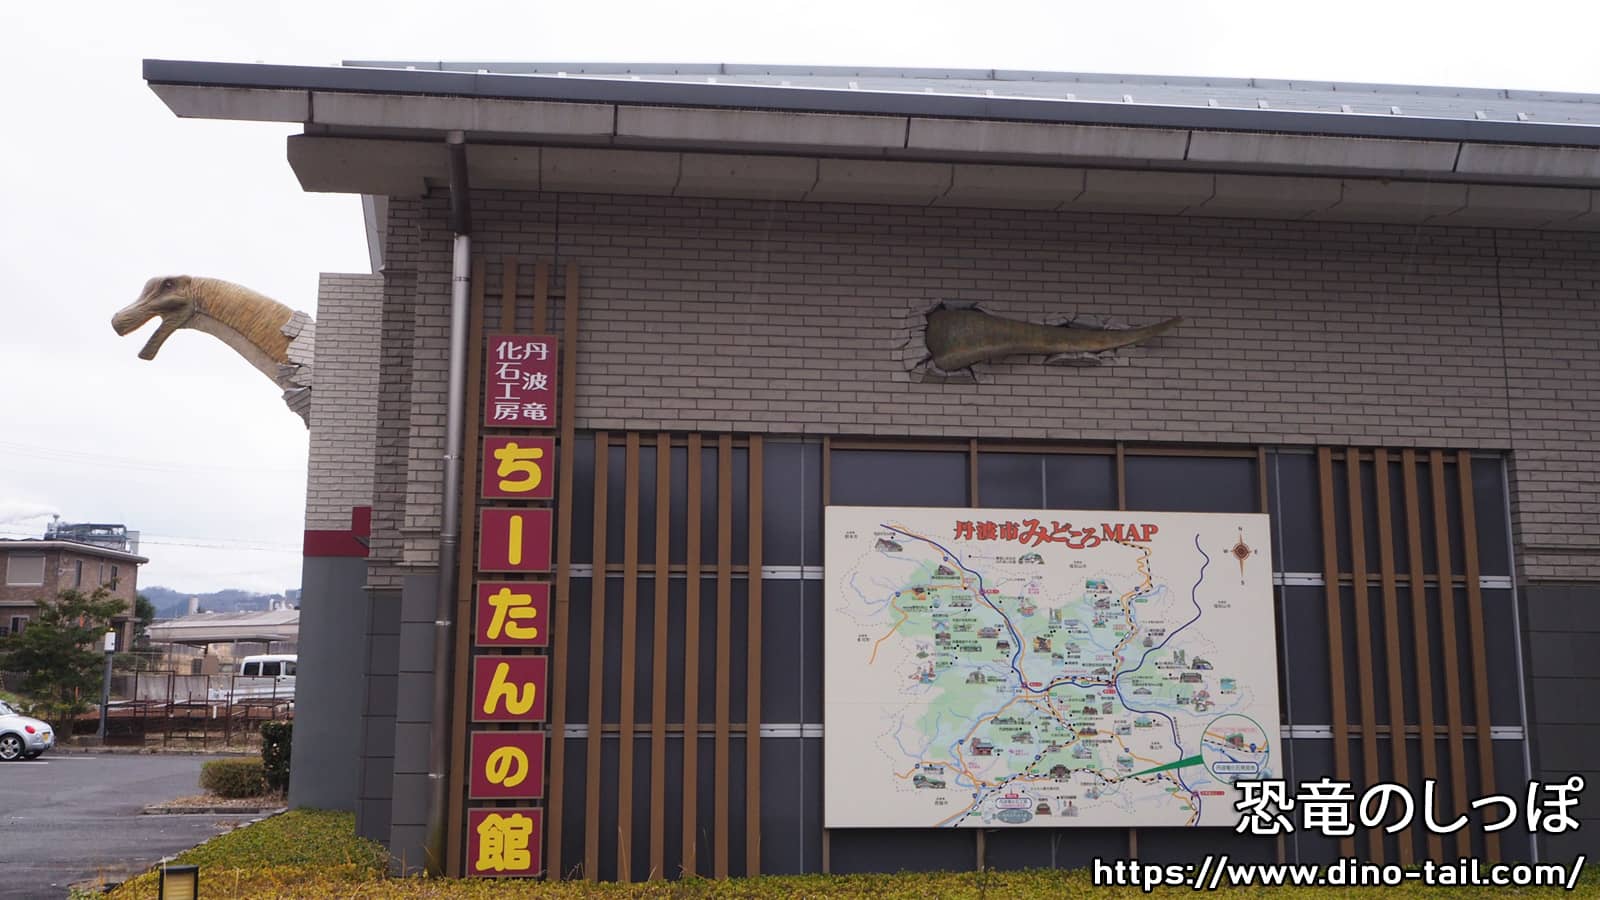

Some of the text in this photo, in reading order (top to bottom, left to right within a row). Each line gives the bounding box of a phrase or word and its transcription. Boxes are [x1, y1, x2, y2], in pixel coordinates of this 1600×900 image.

[493, 341, 523, 421] 化石工房
[522, 342, 549, 421] 丹波竜
[953, 519, 1160, 549] 丹波市みどころMAP
[475, 442, 544, 872] ちーたんの館
